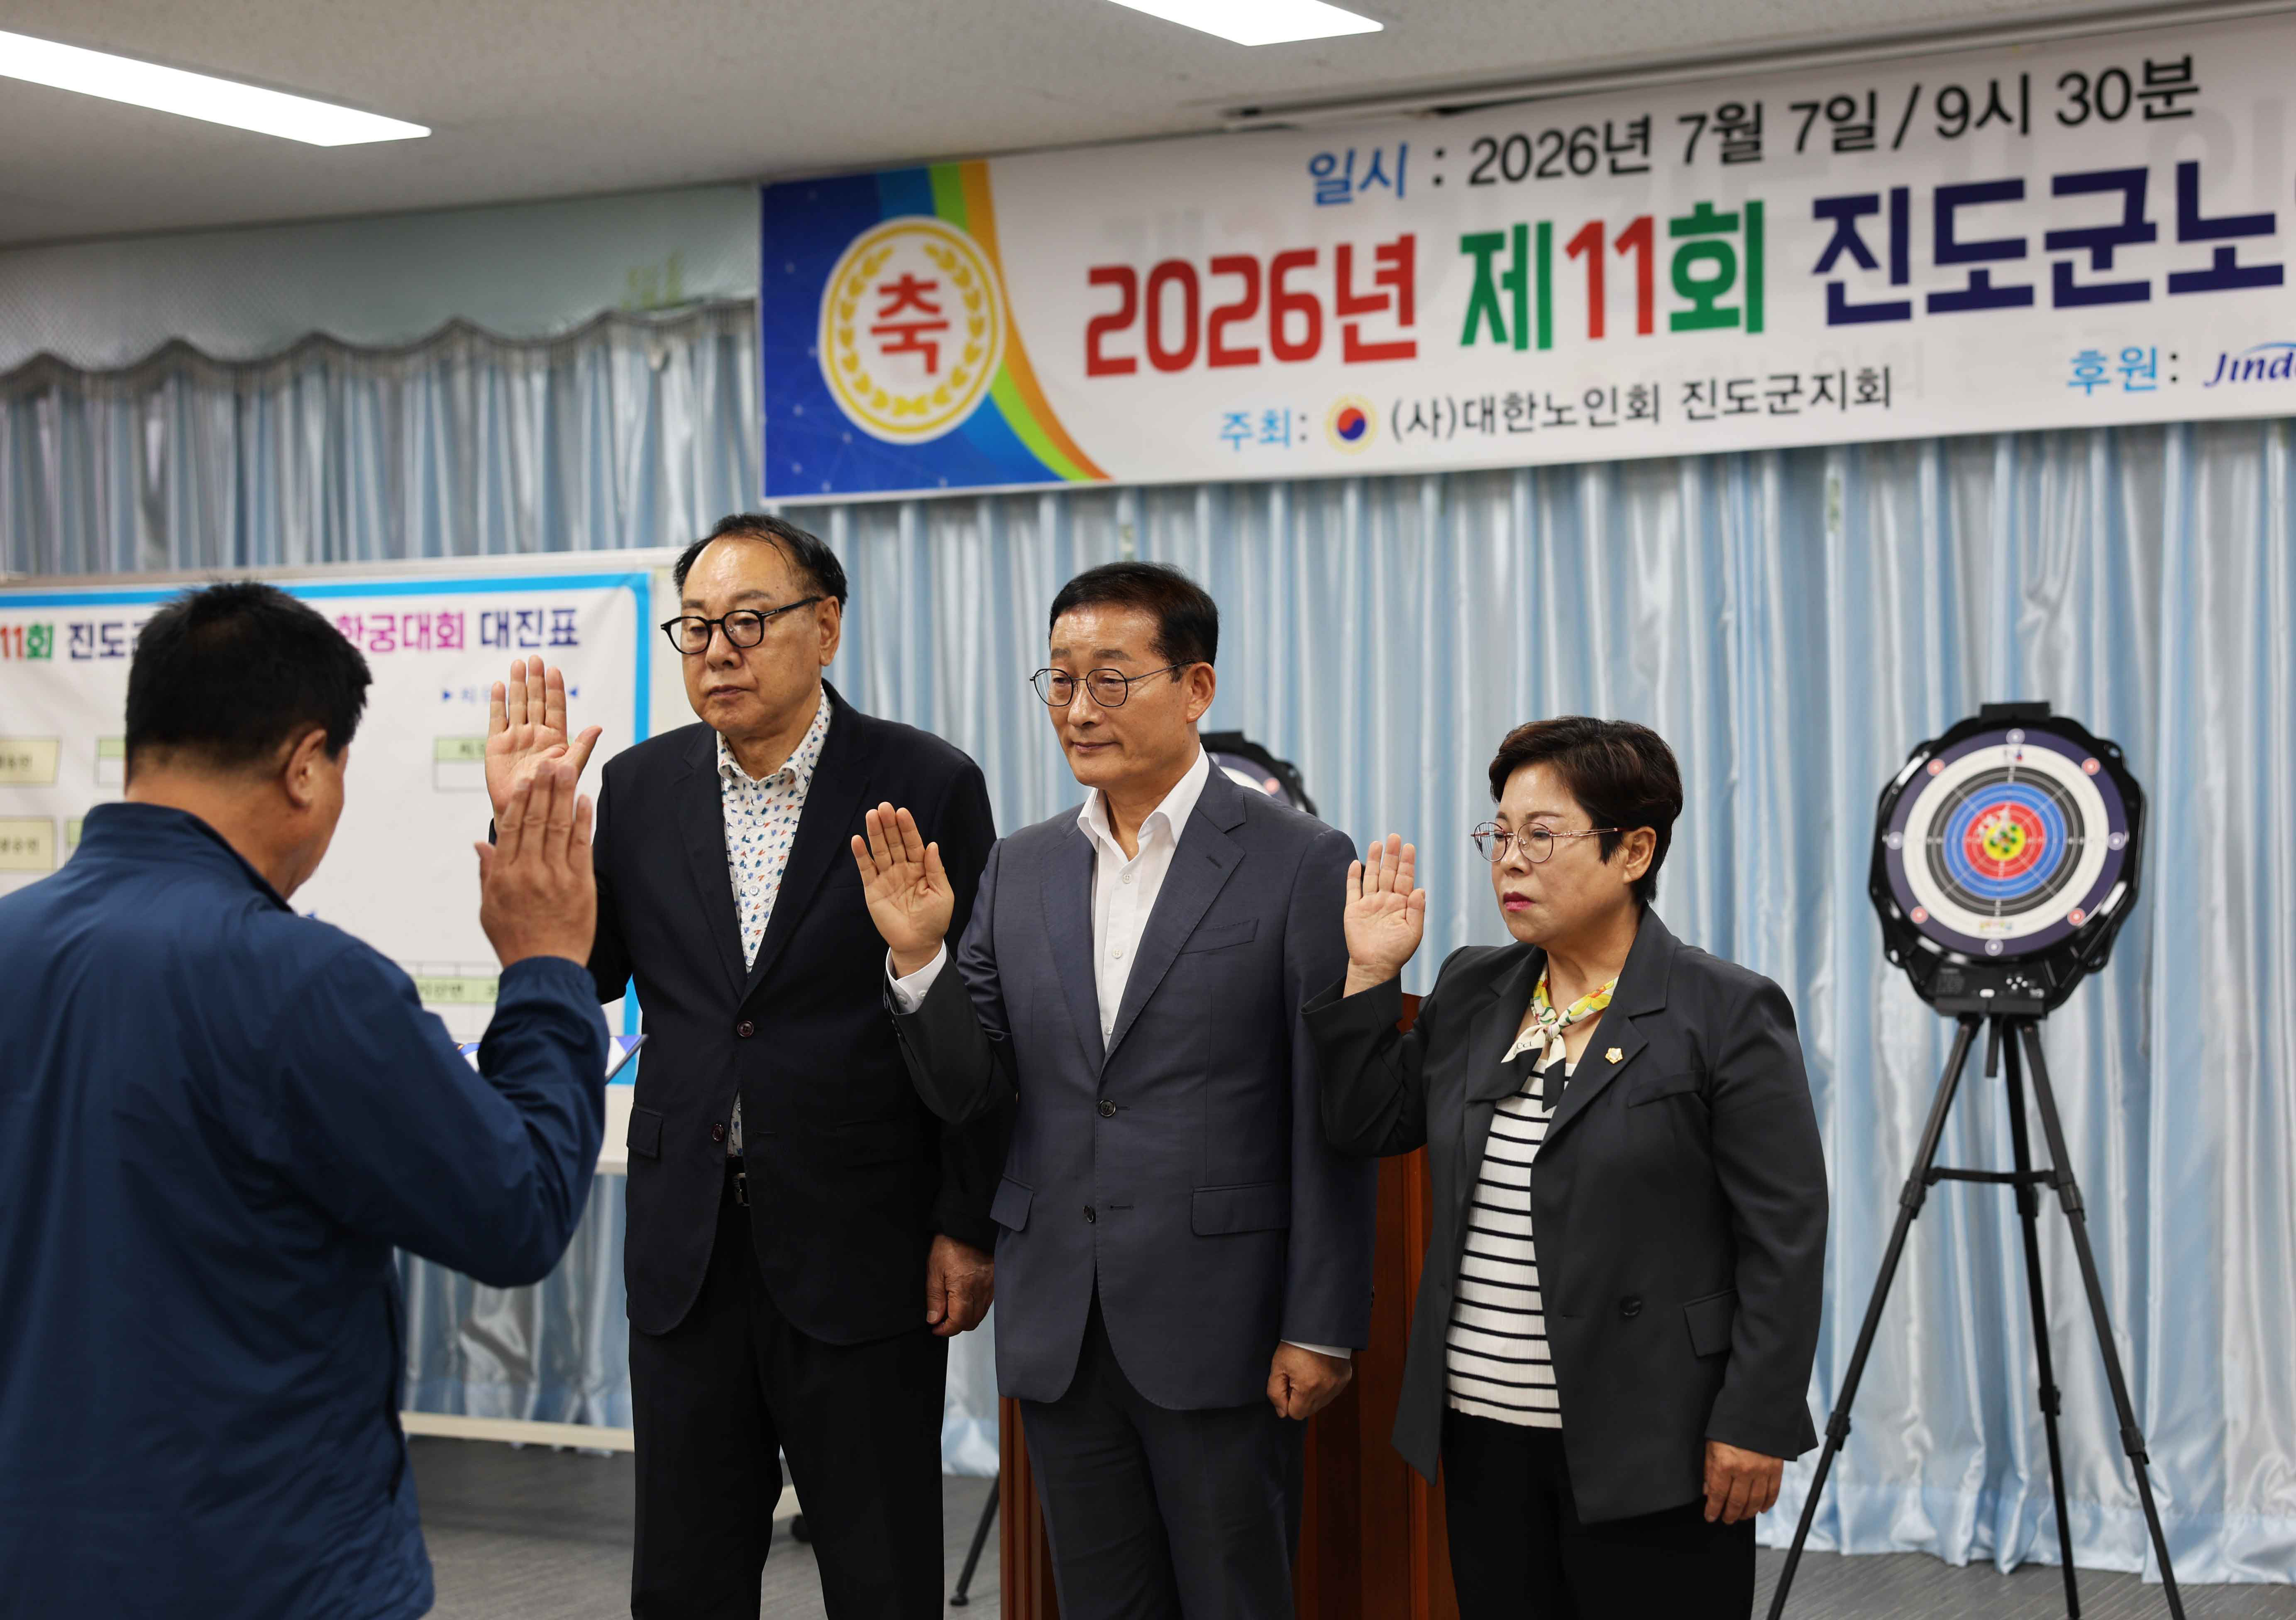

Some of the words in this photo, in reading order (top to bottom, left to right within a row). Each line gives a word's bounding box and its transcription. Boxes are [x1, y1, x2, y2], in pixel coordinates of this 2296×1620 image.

[1309, 142, 1409, 206] 일시
[1468, 113, 1652, 186] 2026년
[1677, 100, 1764, 166] 7월
[2056, 54, 2201, 127] 30분
[1085, 233, 1417, 377] 2026년
[1459, 199, 1765, 351] 제11회
[1812, 160, 2296, 326] 진도군노
[870, 273, 950, 375] 축
[1682, 366, 1891, 421] 진도군지회
[2204, 351, 2296, 388] Jind
[480, 609, 579, 648] 대진표
